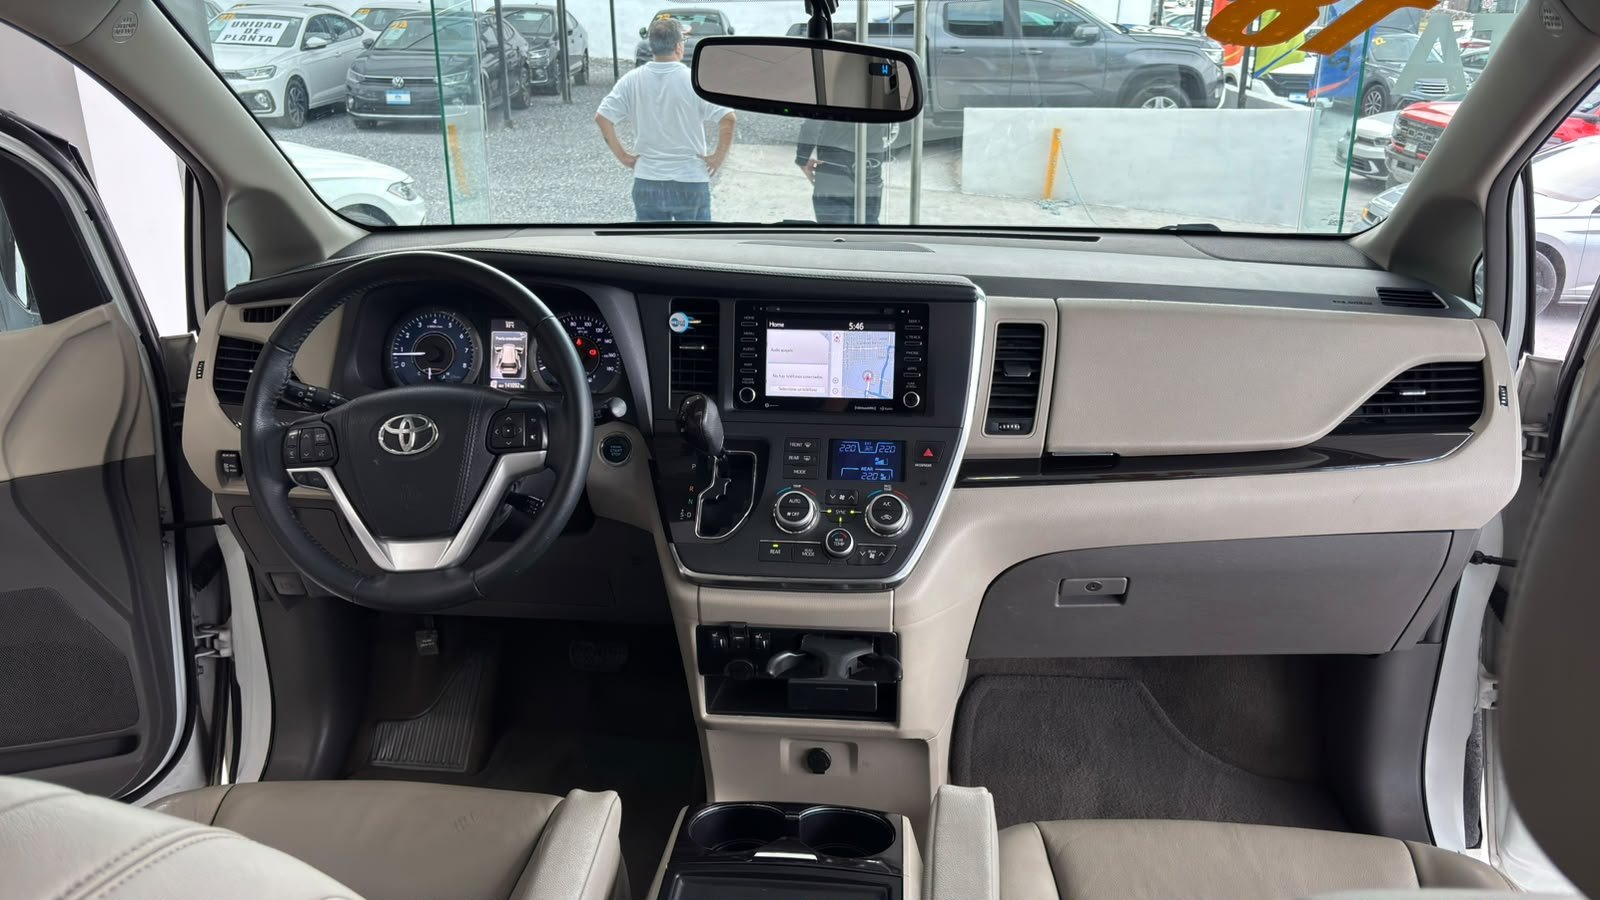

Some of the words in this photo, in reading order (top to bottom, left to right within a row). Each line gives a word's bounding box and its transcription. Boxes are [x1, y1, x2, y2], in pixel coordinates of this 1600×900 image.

[231, 21, 283, 29] UNIDAD
[223, 34, 273, 42] PLANTA
[848, 322, 865, 330] 5:46
